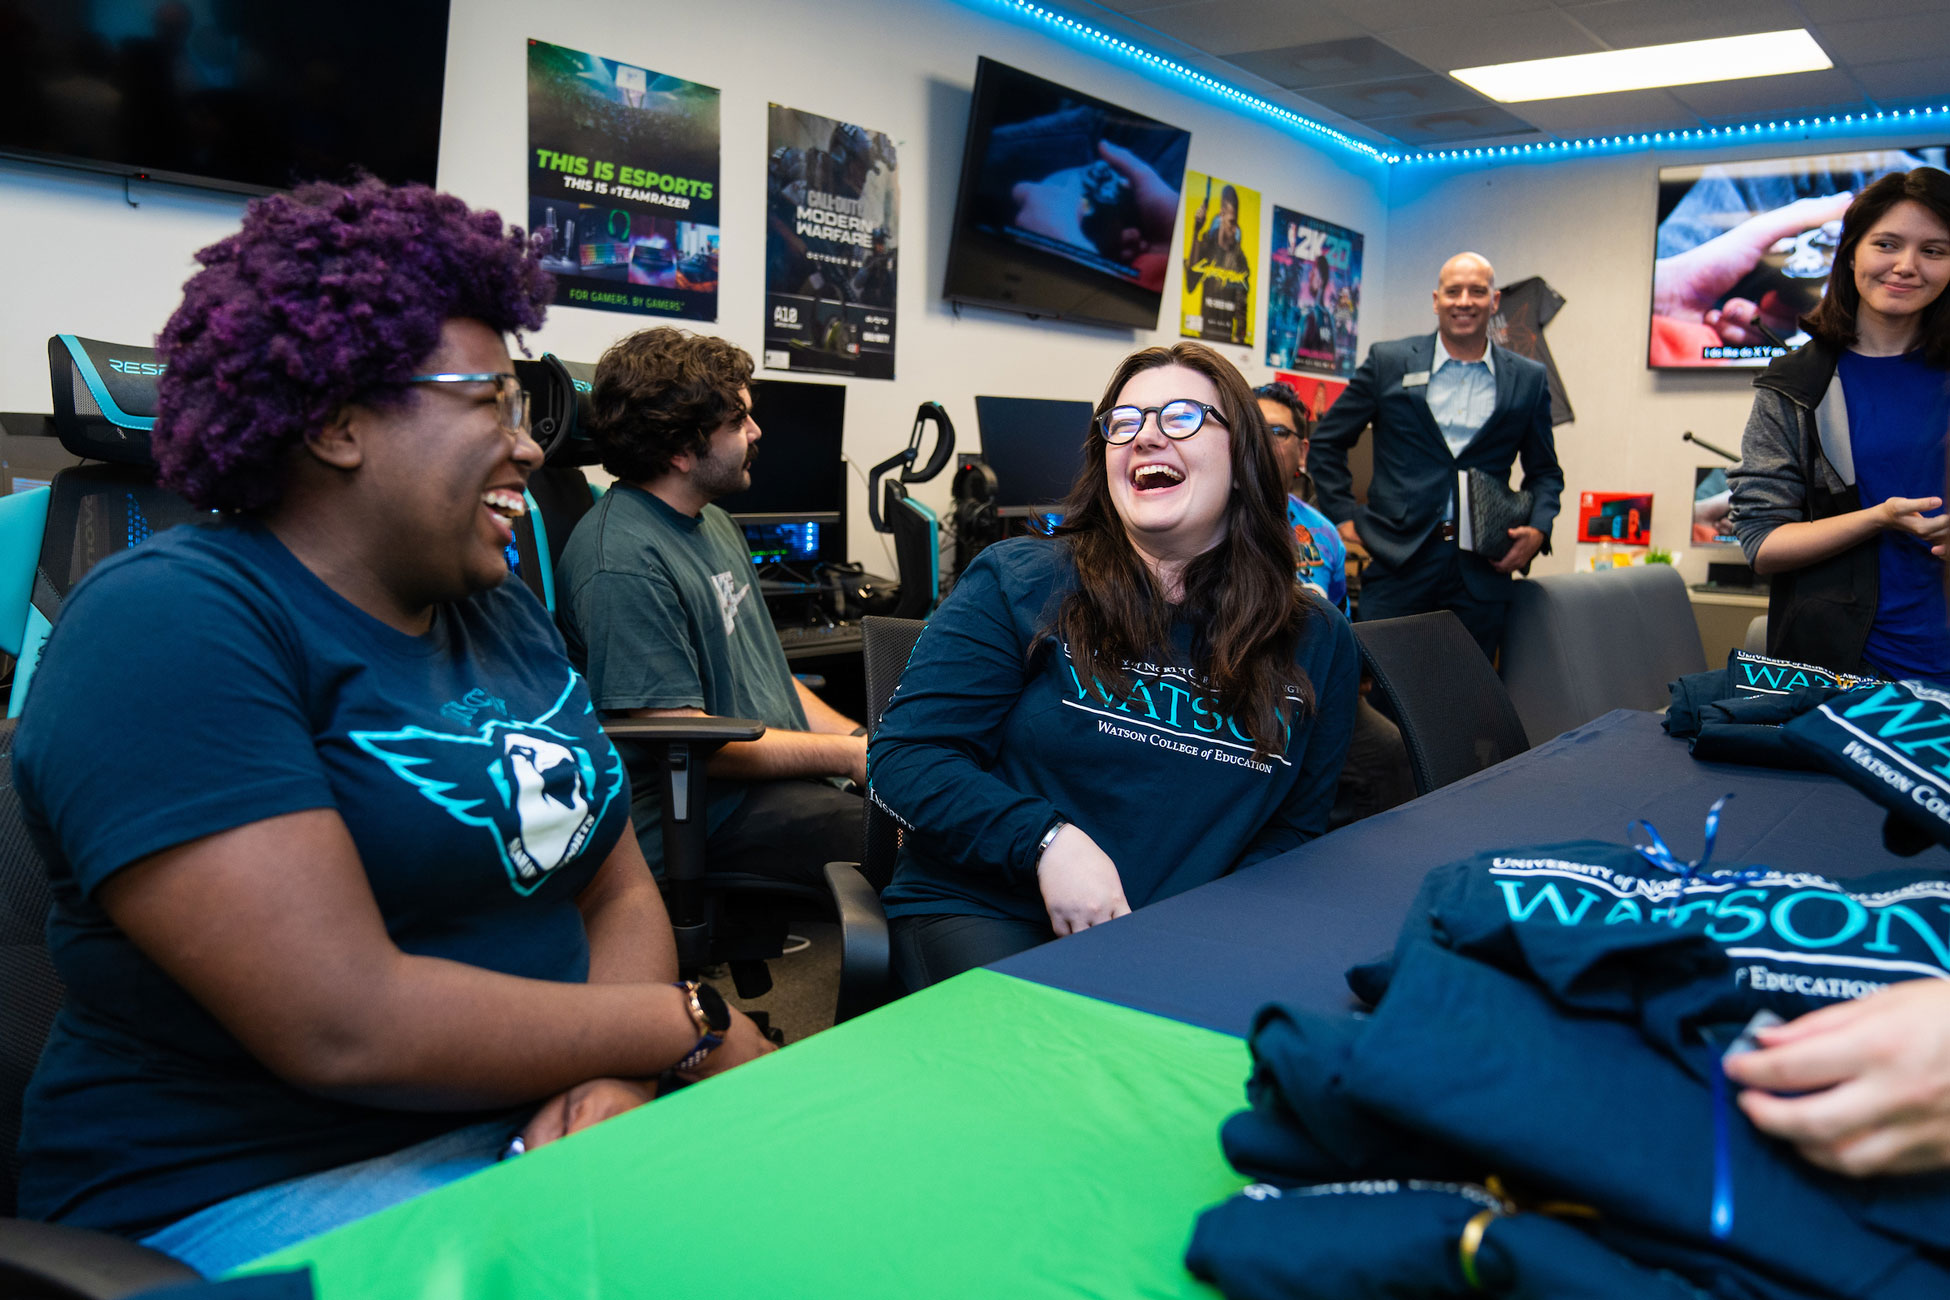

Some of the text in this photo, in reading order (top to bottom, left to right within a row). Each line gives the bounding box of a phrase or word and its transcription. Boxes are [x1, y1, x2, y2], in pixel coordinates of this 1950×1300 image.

[536, 149, 713, 200] THIS IS ESPORTS
[563, 176, 594, 192] THIS
[595, 182, 608, 195] IS
[797, 205, 873, 234] MODERN
[797, 220, 873, 249] WARFARE
[569, 288, 589, 300] FOR
[632, 296, 643, 307] BY
[1737, 650, 1791, 664] UNIVERSITY
[1098, 720, 1273, 774] WATSON COLLEGE of EDUCATION
[1842, 740, 1916, 793] WATSON
[1492, 857, 1614, 881] UNIVERSITY
